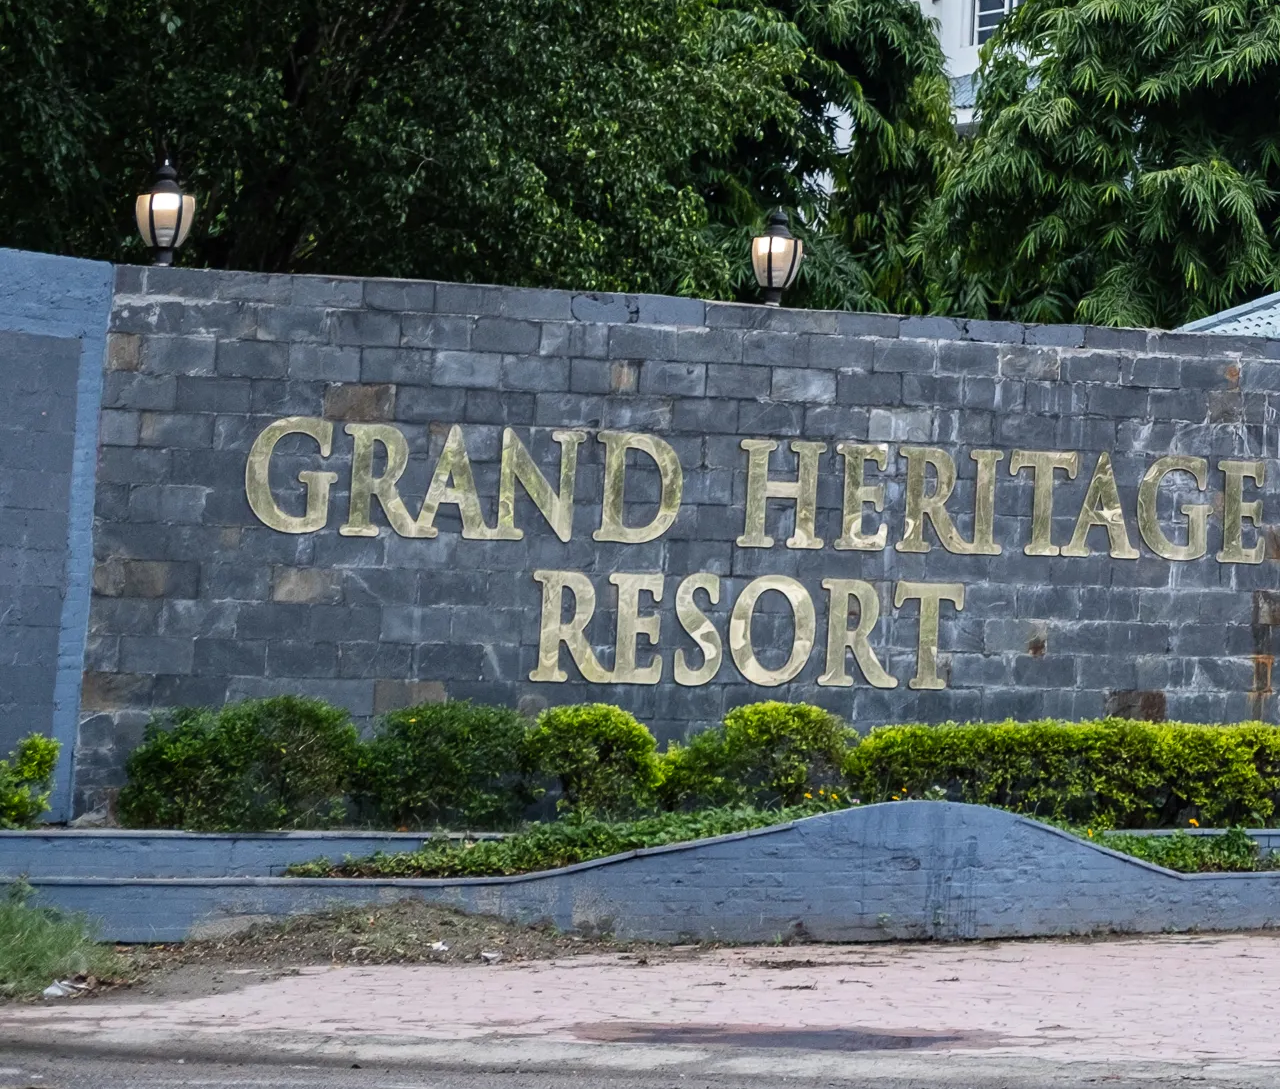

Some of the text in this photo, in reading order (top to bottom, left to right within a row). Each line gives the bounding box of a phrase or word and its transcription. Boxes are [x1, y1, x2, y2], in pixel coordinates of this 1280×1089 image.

[245, 416, 1266, 564] GRAND HERITAGE
[529, 570, 966, 690] RESORT
